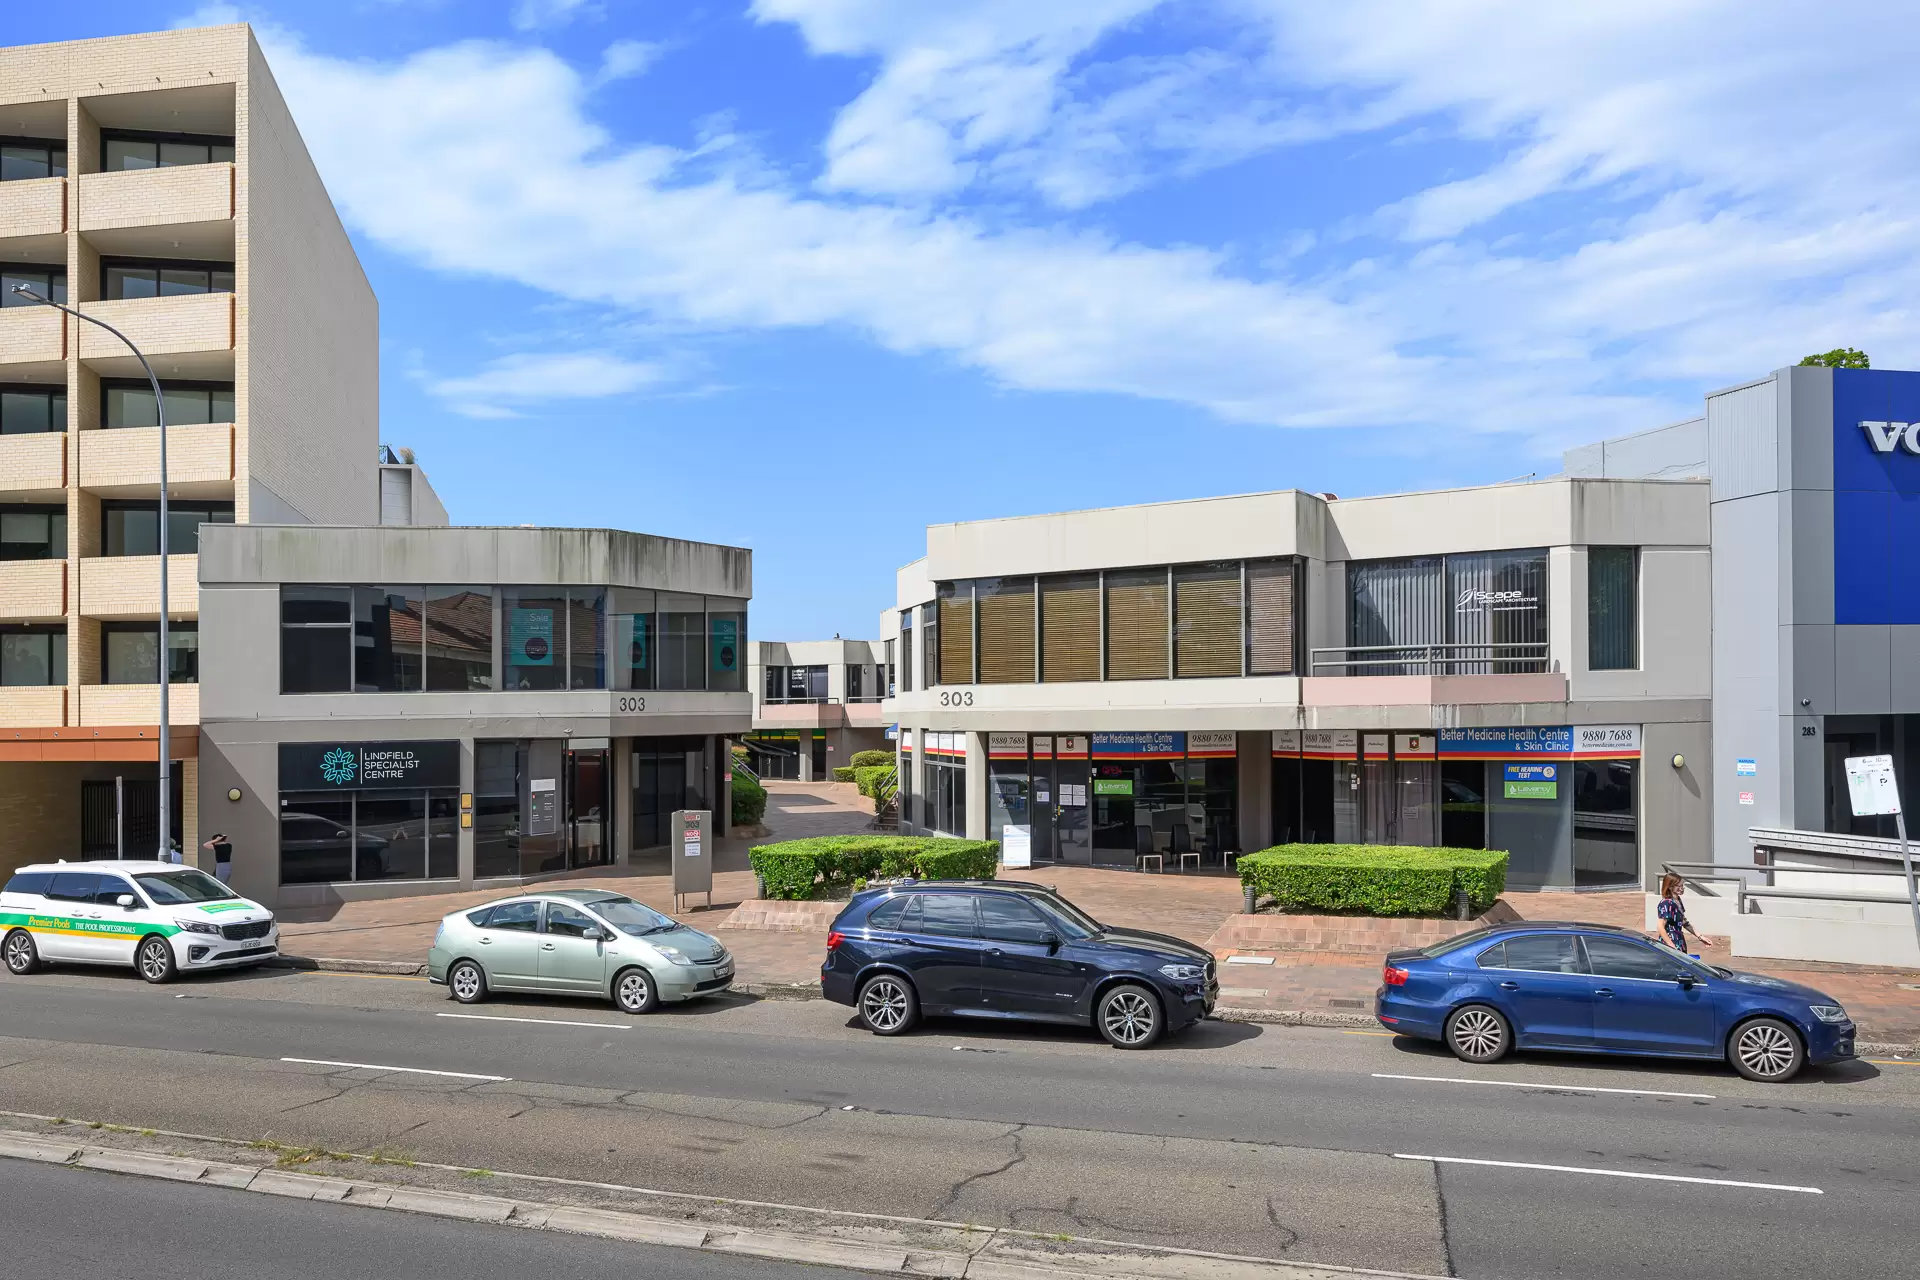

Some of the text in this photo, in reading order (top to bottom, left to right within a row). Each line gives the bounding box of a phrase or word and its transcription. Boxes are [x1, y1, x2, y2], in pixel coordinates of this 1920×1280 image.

[620, 697, 645, 711] 303
[940, 692, 973, 706] 303
[1440, 728, 1569, 740] Better Medicine Health Centre
[1582, 730, 1632, 741] 9880 7688
[1802, 726, 1816, 736] 283
[1092, 733, 1172, 744] Better Medicine Health Centre
[1192, 734, 1232, 742] 9880 7688
[1524, 742, 1542, 750] Skin
[1545, 741, 1569, 750] Clinic
[364, 751, 414, 760] LINDFIELD
[364, 760, 420, 769] SPECIALIST
[364, 770, 403, 778] CENTRE
[28, 916, 70, 928] Premier Pools
[99, 924, 135, 933] PROFESSIONALS
